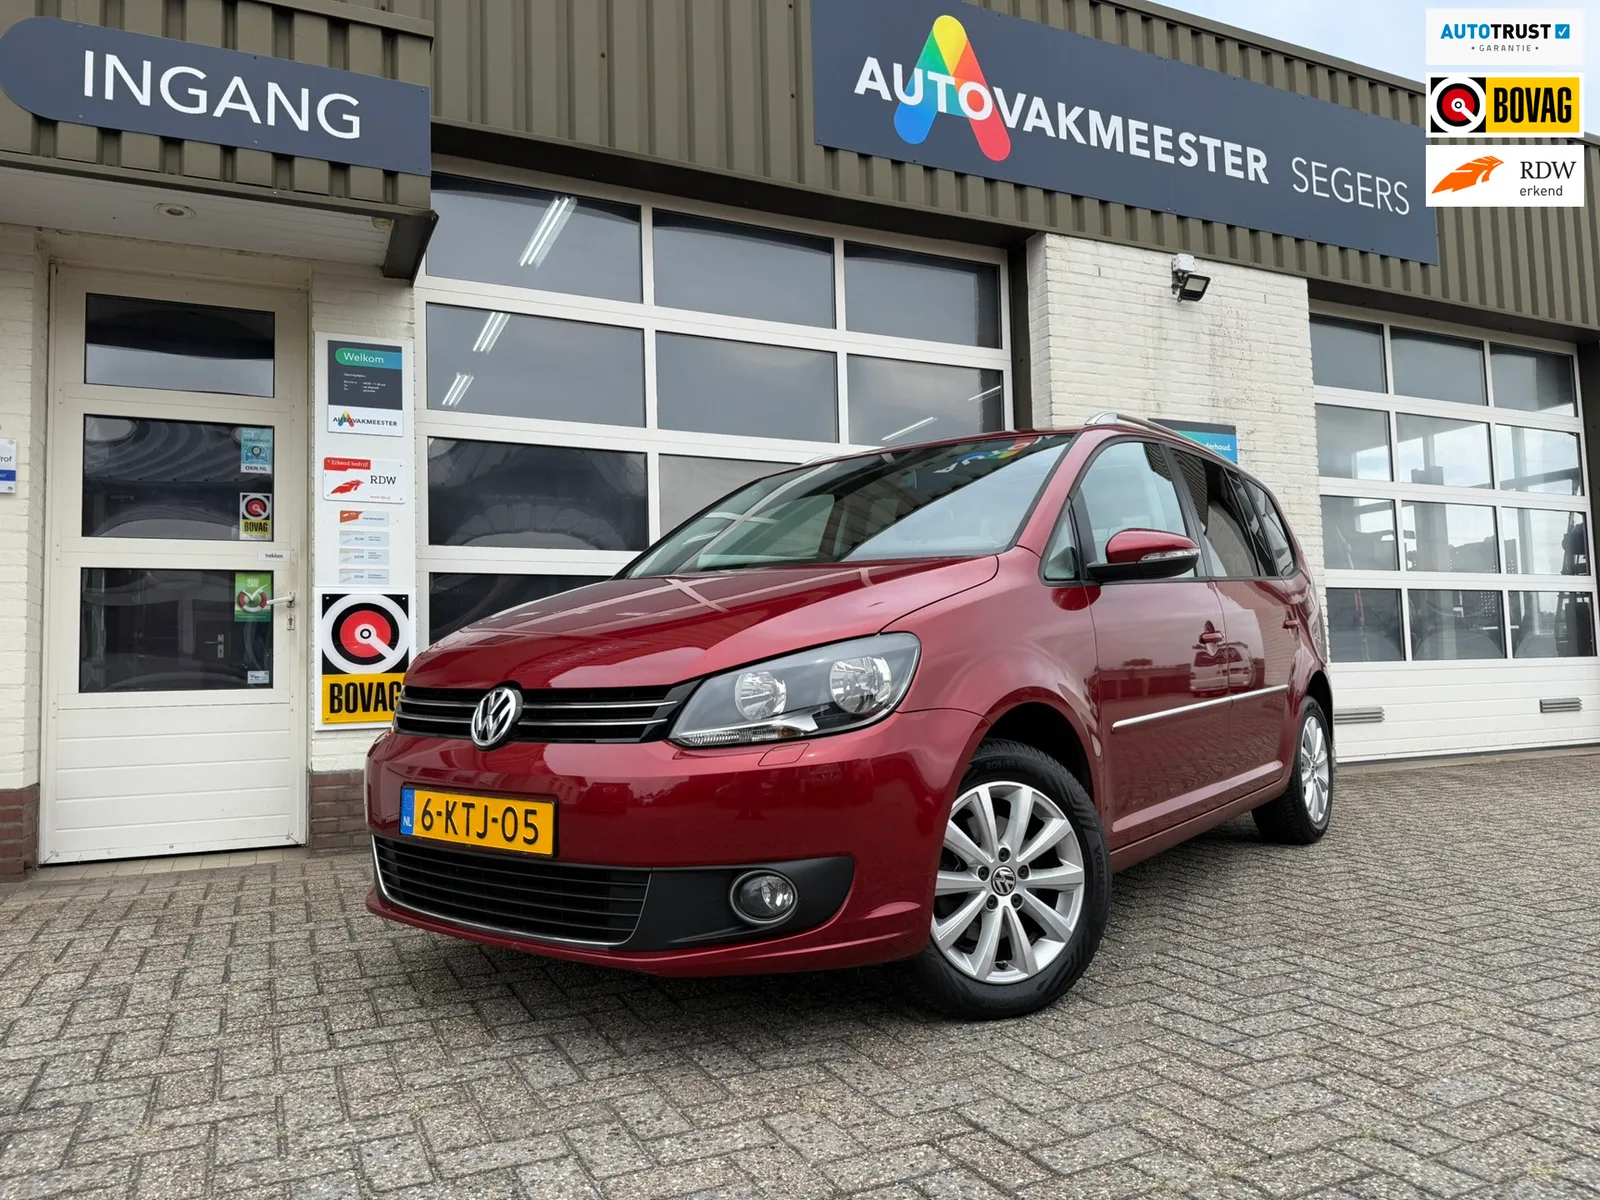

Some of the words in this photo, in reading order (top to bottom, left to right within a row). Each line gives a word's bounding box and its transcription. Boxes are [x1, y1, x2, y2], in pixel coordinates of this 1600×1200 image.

[83, 49, 361, 140] INGANG
[853, 55, 1270, 185] AUTOVAKMEESTER
[1291, 156, 1410, 216] SEGERS
[343, 351, 384, 364] Welkom
[333, 416, 398, 427] AUTOVAKMEESTER
[331, 460, 350, 468] Erkend
[351, 461, 369, 469] bedrijf
[370, 475, 397, 485] RDW
[244, 522, 268, 532] BOVAG
[403, 816, 413, 828] NL
[420, 797, 539, 846] 6-KTJ-05
